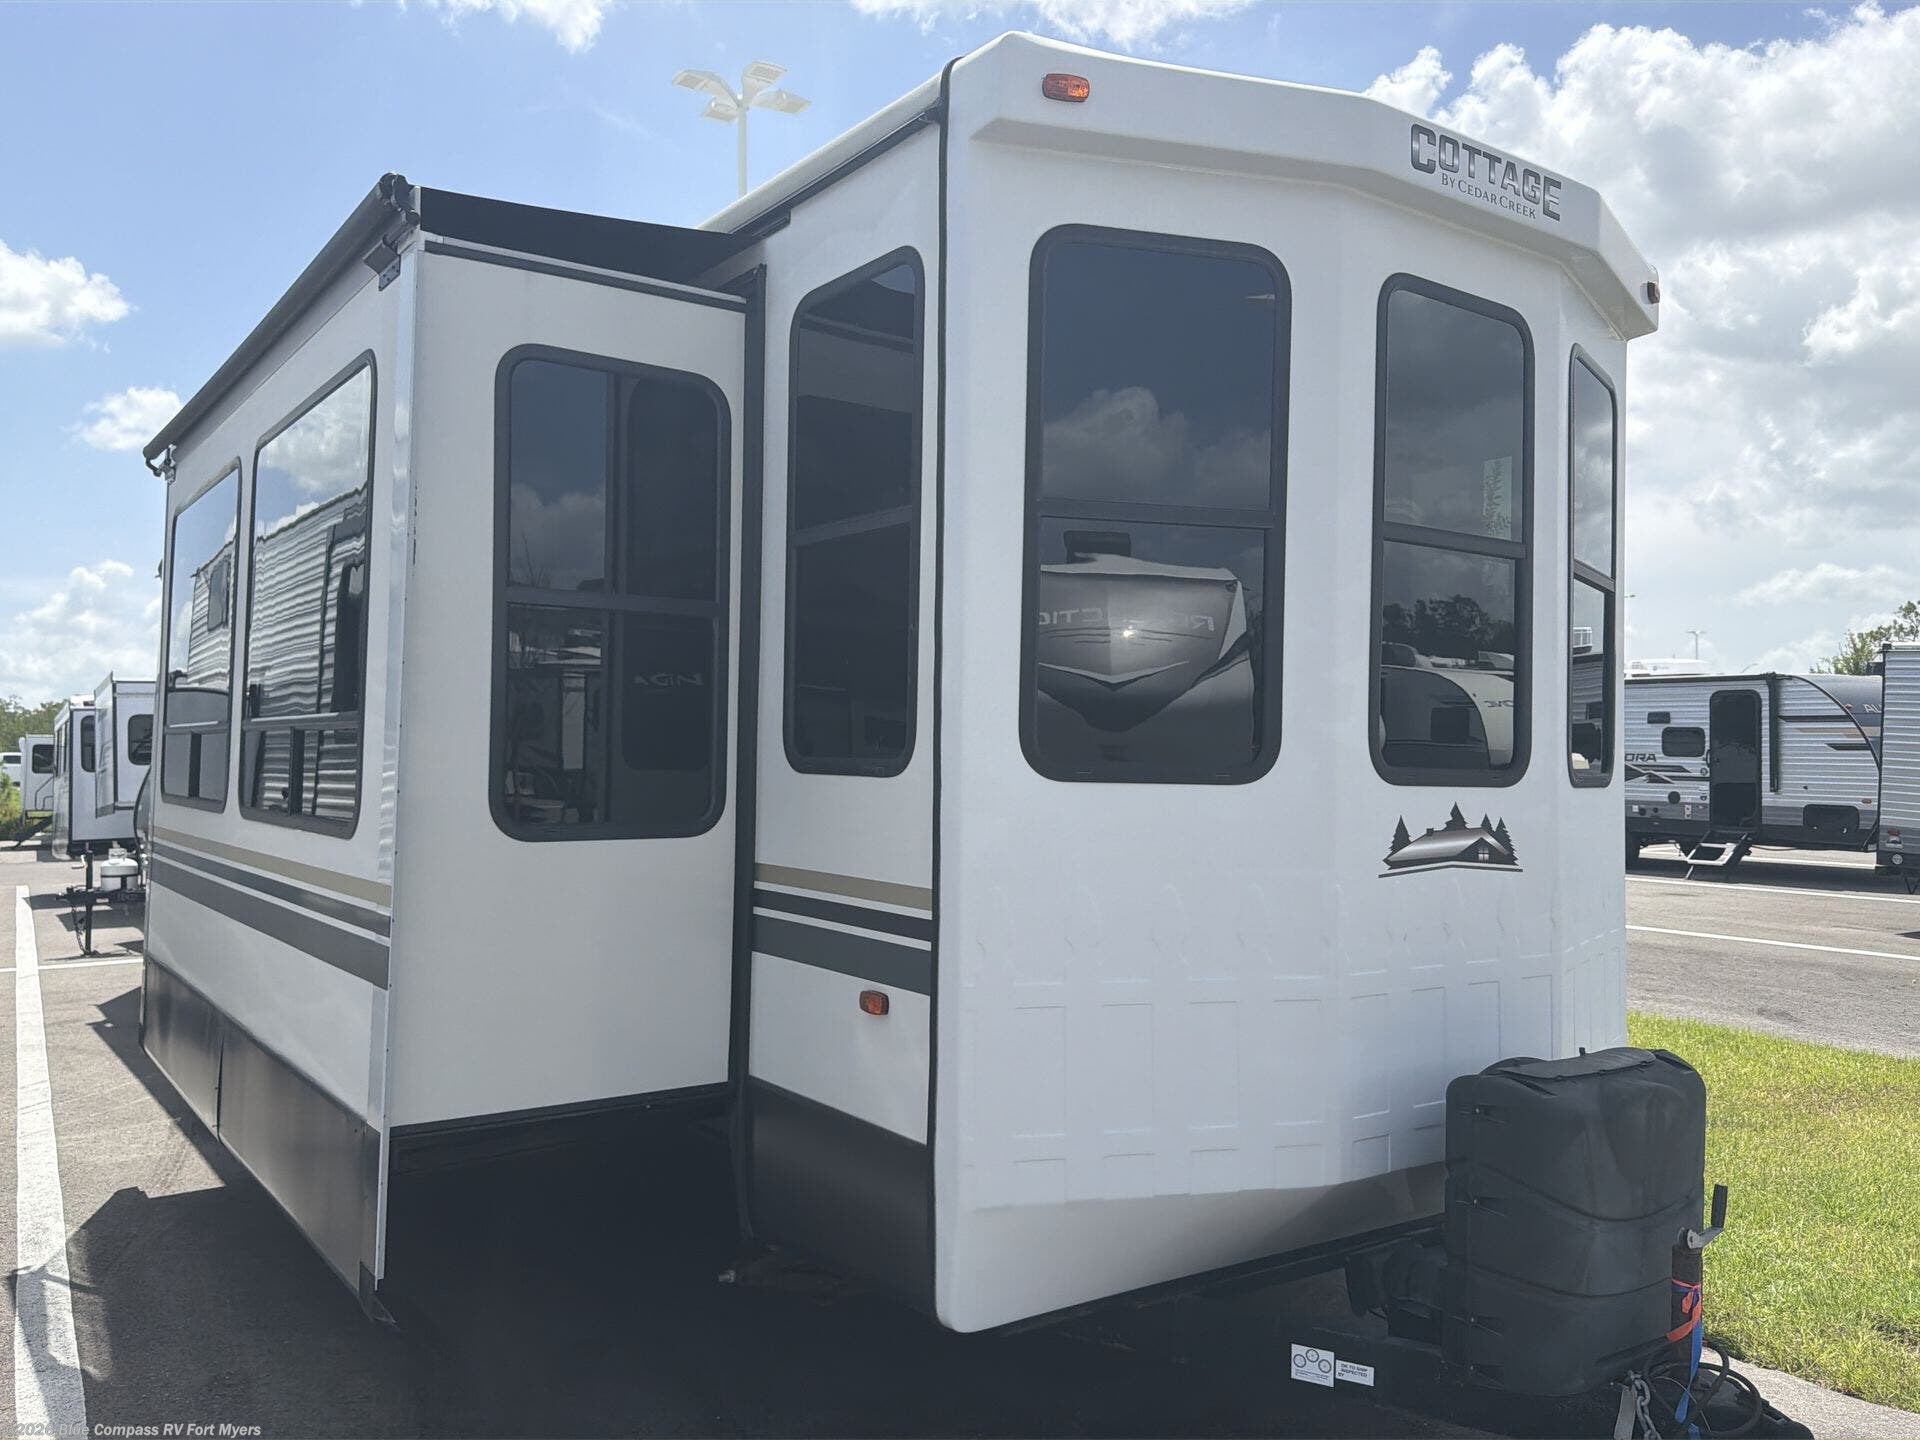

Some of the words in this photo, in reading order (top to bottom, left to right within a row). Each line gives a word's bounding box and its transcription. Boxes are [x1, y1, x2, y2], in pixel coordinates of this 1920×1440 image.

[1411, 123, 1562, 222] COTTAGE
[1441, 172, 1456, 188] BY
[1458, 180, 1498, 206] CEDAR
[1500, 196, 1537, 220] CREEK
